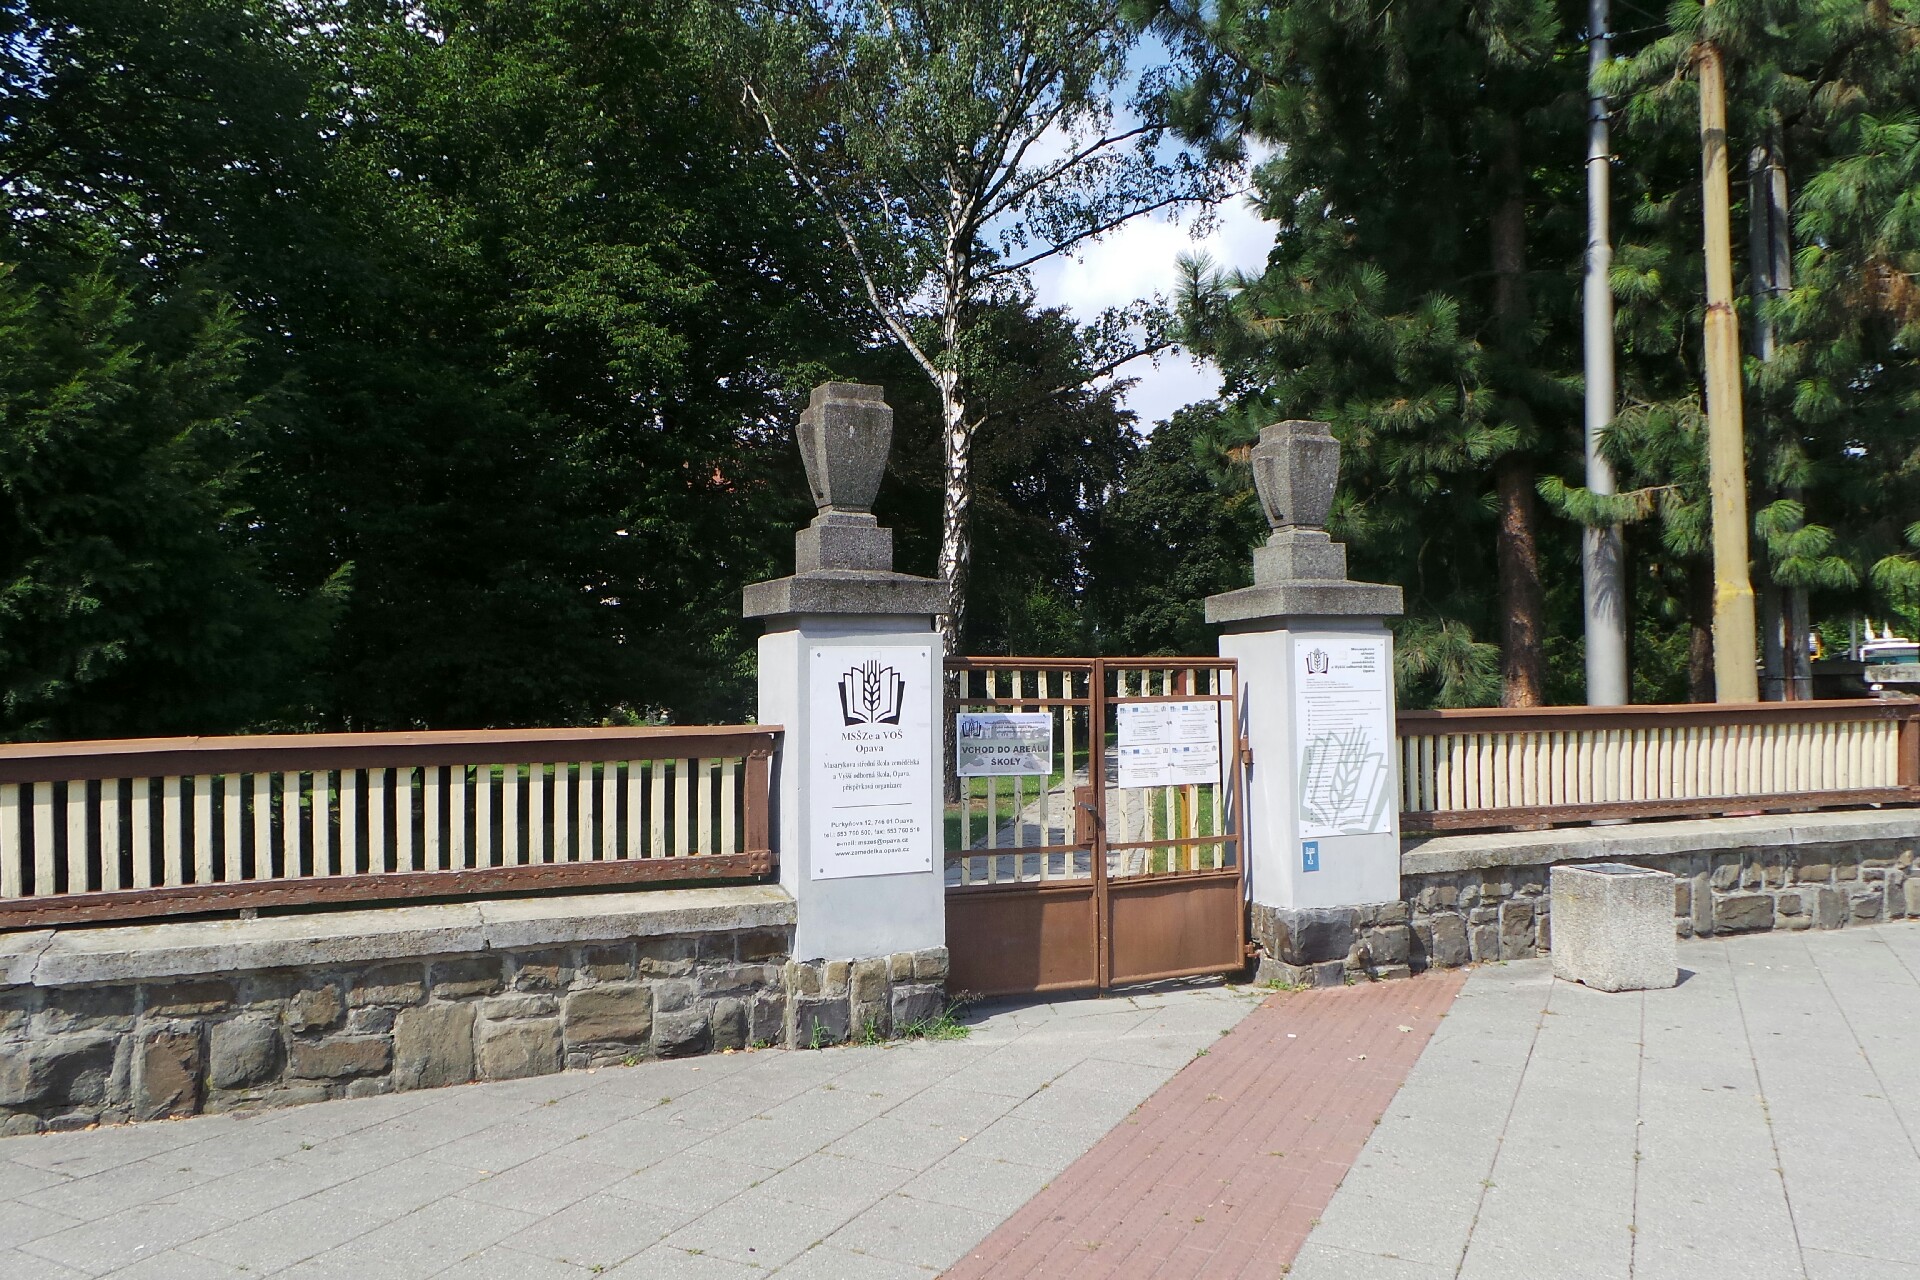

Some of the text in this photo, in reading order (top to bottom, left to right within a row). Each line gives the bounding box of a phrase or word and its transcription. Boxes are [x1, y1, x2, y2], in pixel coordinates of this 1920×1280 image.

[883, 729, 903, 740] VOŠ
[855, 744, 884, 754] Opava
[961, 746, 994, 754] VCHOD
[1013, 744, 1049, 753] AREÁLU
[991, 757, 1021, 766] ŠKOLY
